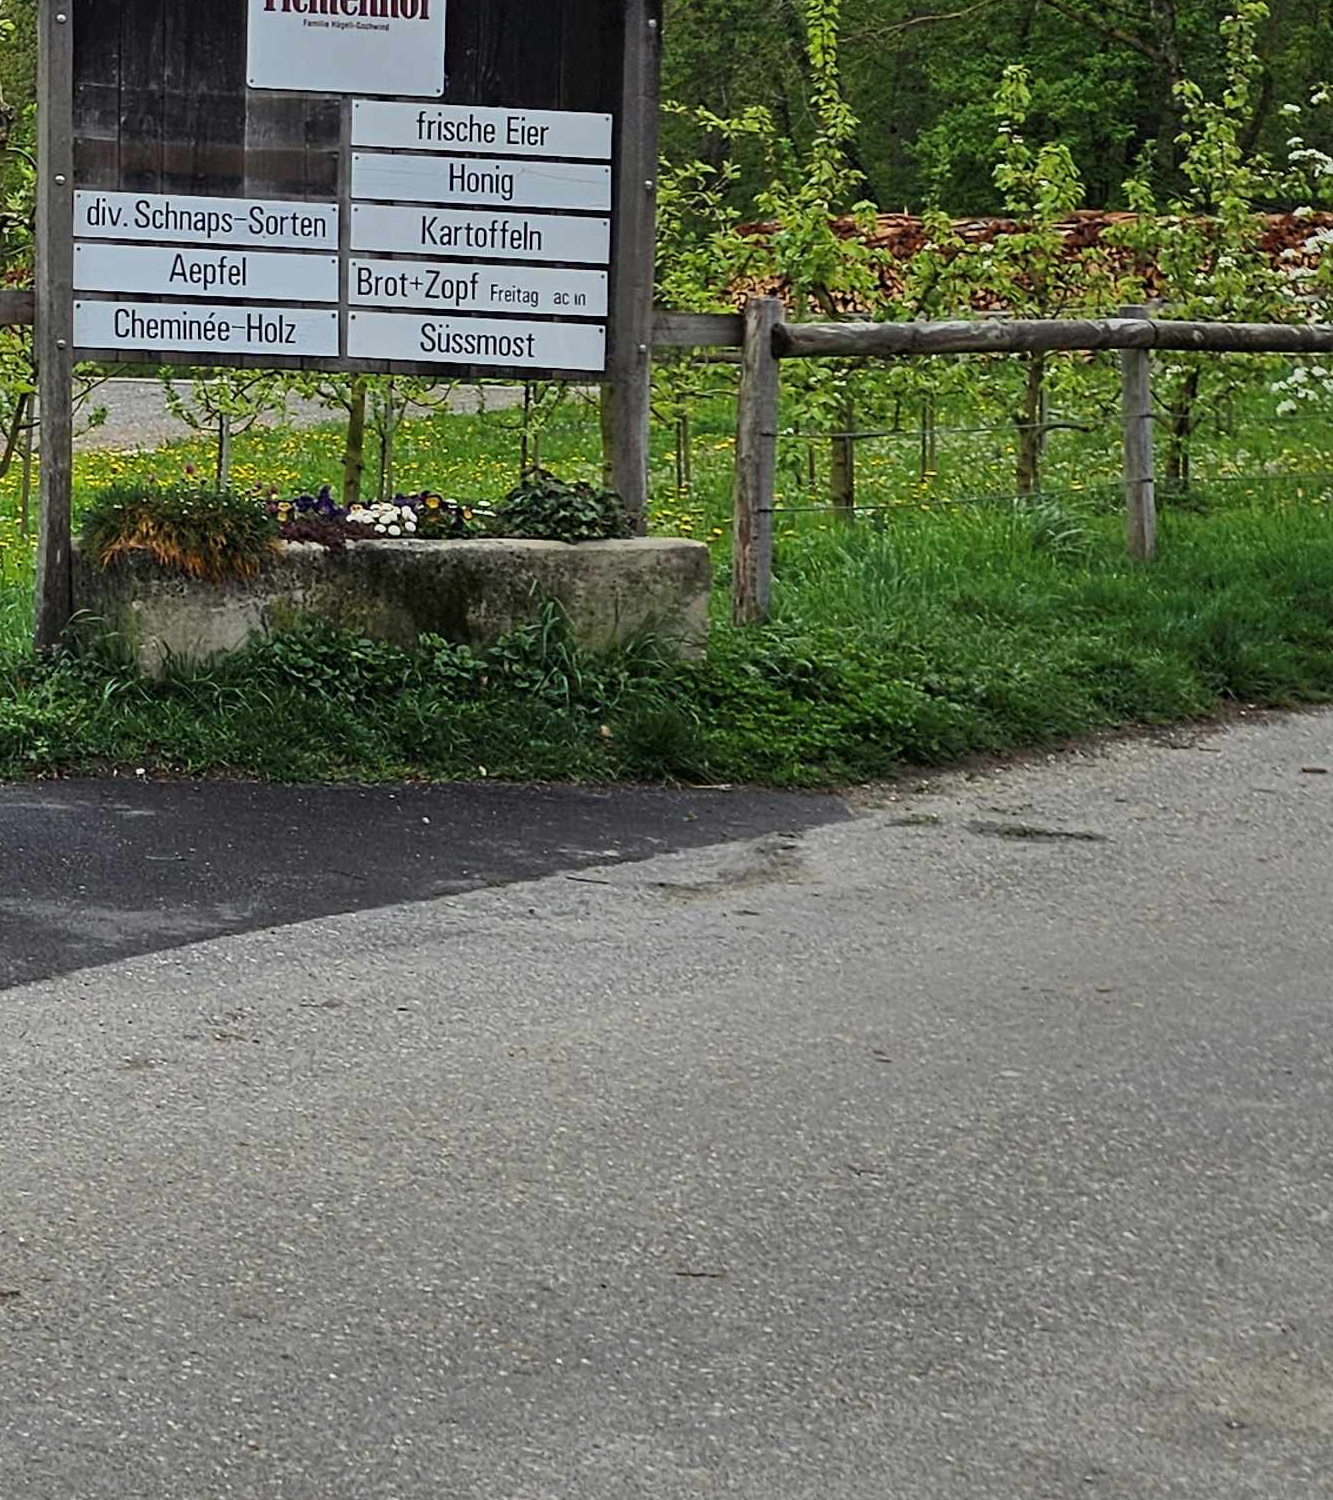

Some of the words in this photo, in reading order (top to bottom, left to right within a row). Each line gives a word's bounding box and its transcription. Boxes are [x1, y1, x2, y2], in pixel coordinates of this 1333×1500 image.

[416, 110, 496, 143] frische
[506, 116, 550, 146] Eier
[448, 163, 514, 201] Honig
[86, 197, 129, 228] div.
[134, 199, 327, 238] Schnaps-Sorten
[421, 215, 542, 251] Kartoffeln
[169, 253, 247, 291] Aepfel
[356, 267, 480, 307] Brot+Zopf
[489, 283, 539, 308] Freitag
[114, 308, 297, 345] Cheminée-Holz
[420, 322, 536, 358] Süssmost
